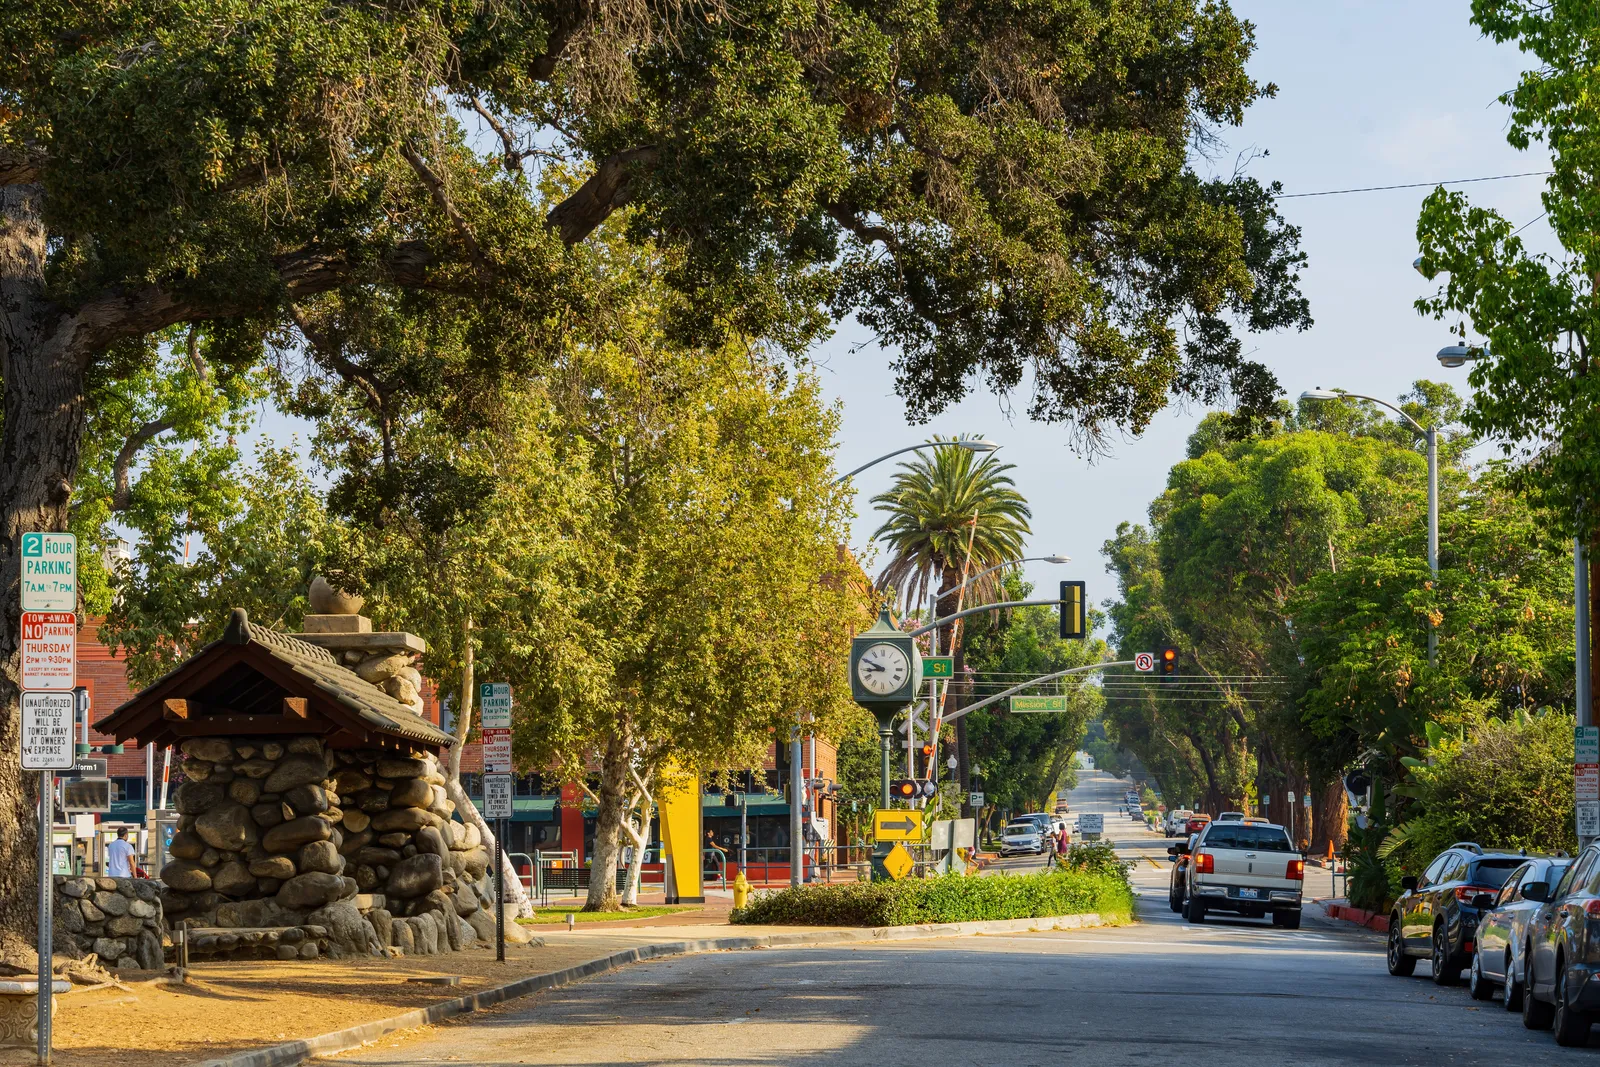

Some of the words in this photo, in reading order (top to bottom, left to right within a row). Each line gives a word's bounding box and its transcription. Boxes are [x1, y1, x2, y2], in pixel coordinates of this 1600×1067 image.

[28, 536, 39, 553] 2
[46, 542, 72, 554] HOUR
[27, 561, 71, 574] PARKING
[28, 614, 70, 622] TOW-AWAY
[25, 624, 41, 638] NO
[44, 627, 73, 636] PARKING
[26, 644, 70, 652] THURSDAY
[933, 663, 946, 673] St
[485, 686, 490, 696] 2
[34, 709, 62, 717] VEHICLES
[53, 718, 60, 726] BE
[28, 727, 47, 735] TOWED
[41, 737, 65, 745] OWNER'S
[34, 746, 61, 754] EXPENSE
